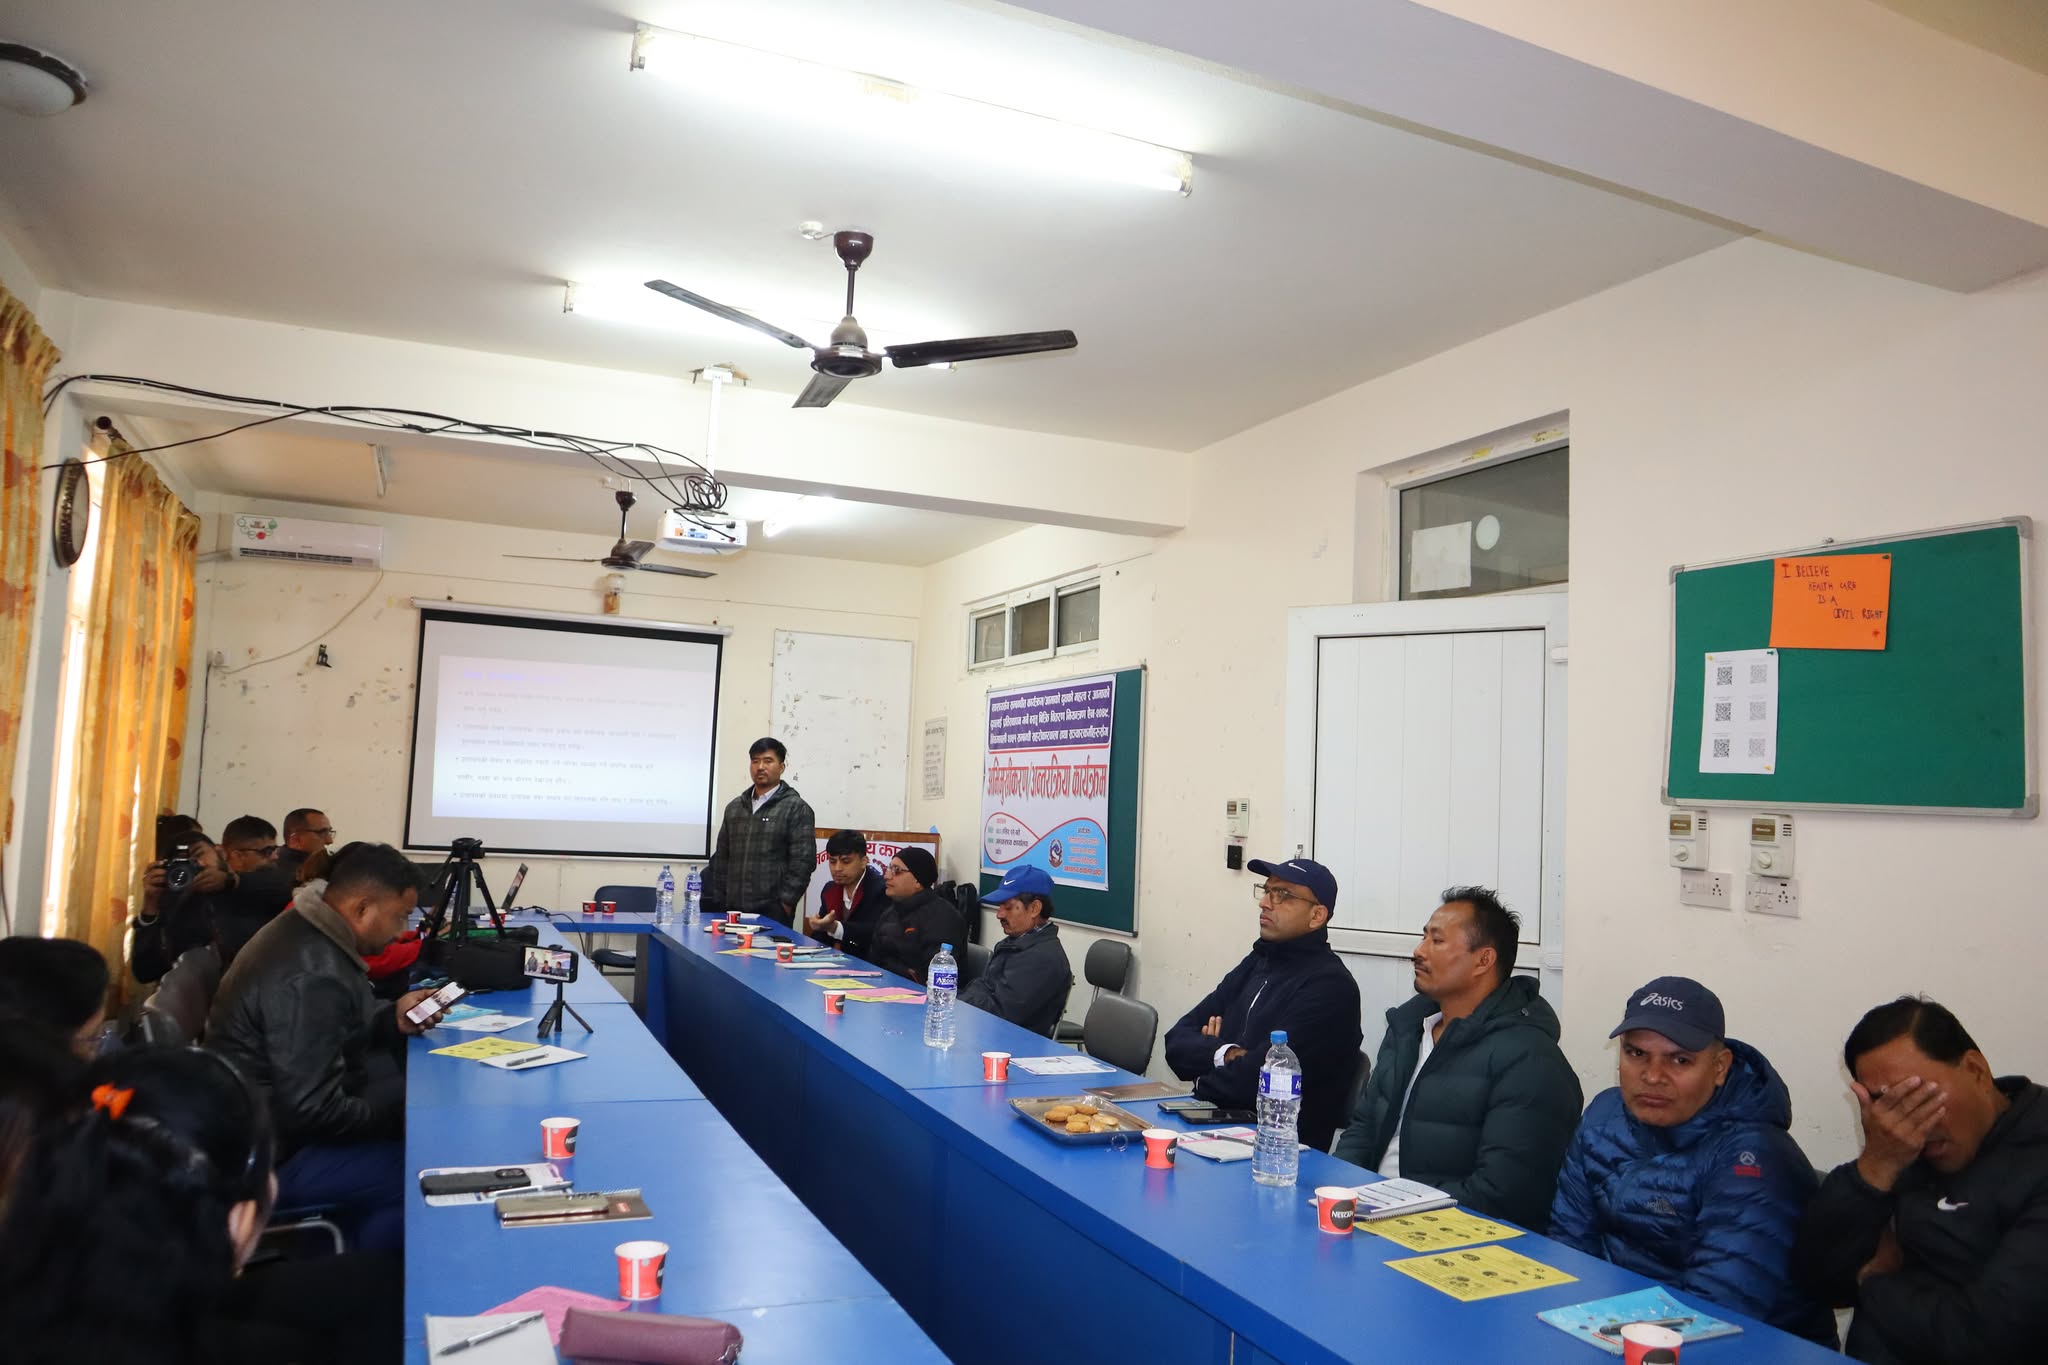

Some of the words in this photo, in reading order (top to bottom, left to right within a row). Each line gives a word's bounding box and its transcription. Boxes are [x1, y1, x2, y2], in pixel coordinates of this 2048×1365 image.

[1795, 564, 1829, 578] BELIEVE
[1808, 581, 1834, 591] HEALTH
[1839, 581, 1857, 591] CARE
[1817, 594, 1826, 604] IS
[1830, 595, 1838, 606] A
[1861, 607, 1884, 619] RIGHT
[1072, 754, 1107, 800] कार्यक्रम
[1651, 994, 1684, 1011] asics
